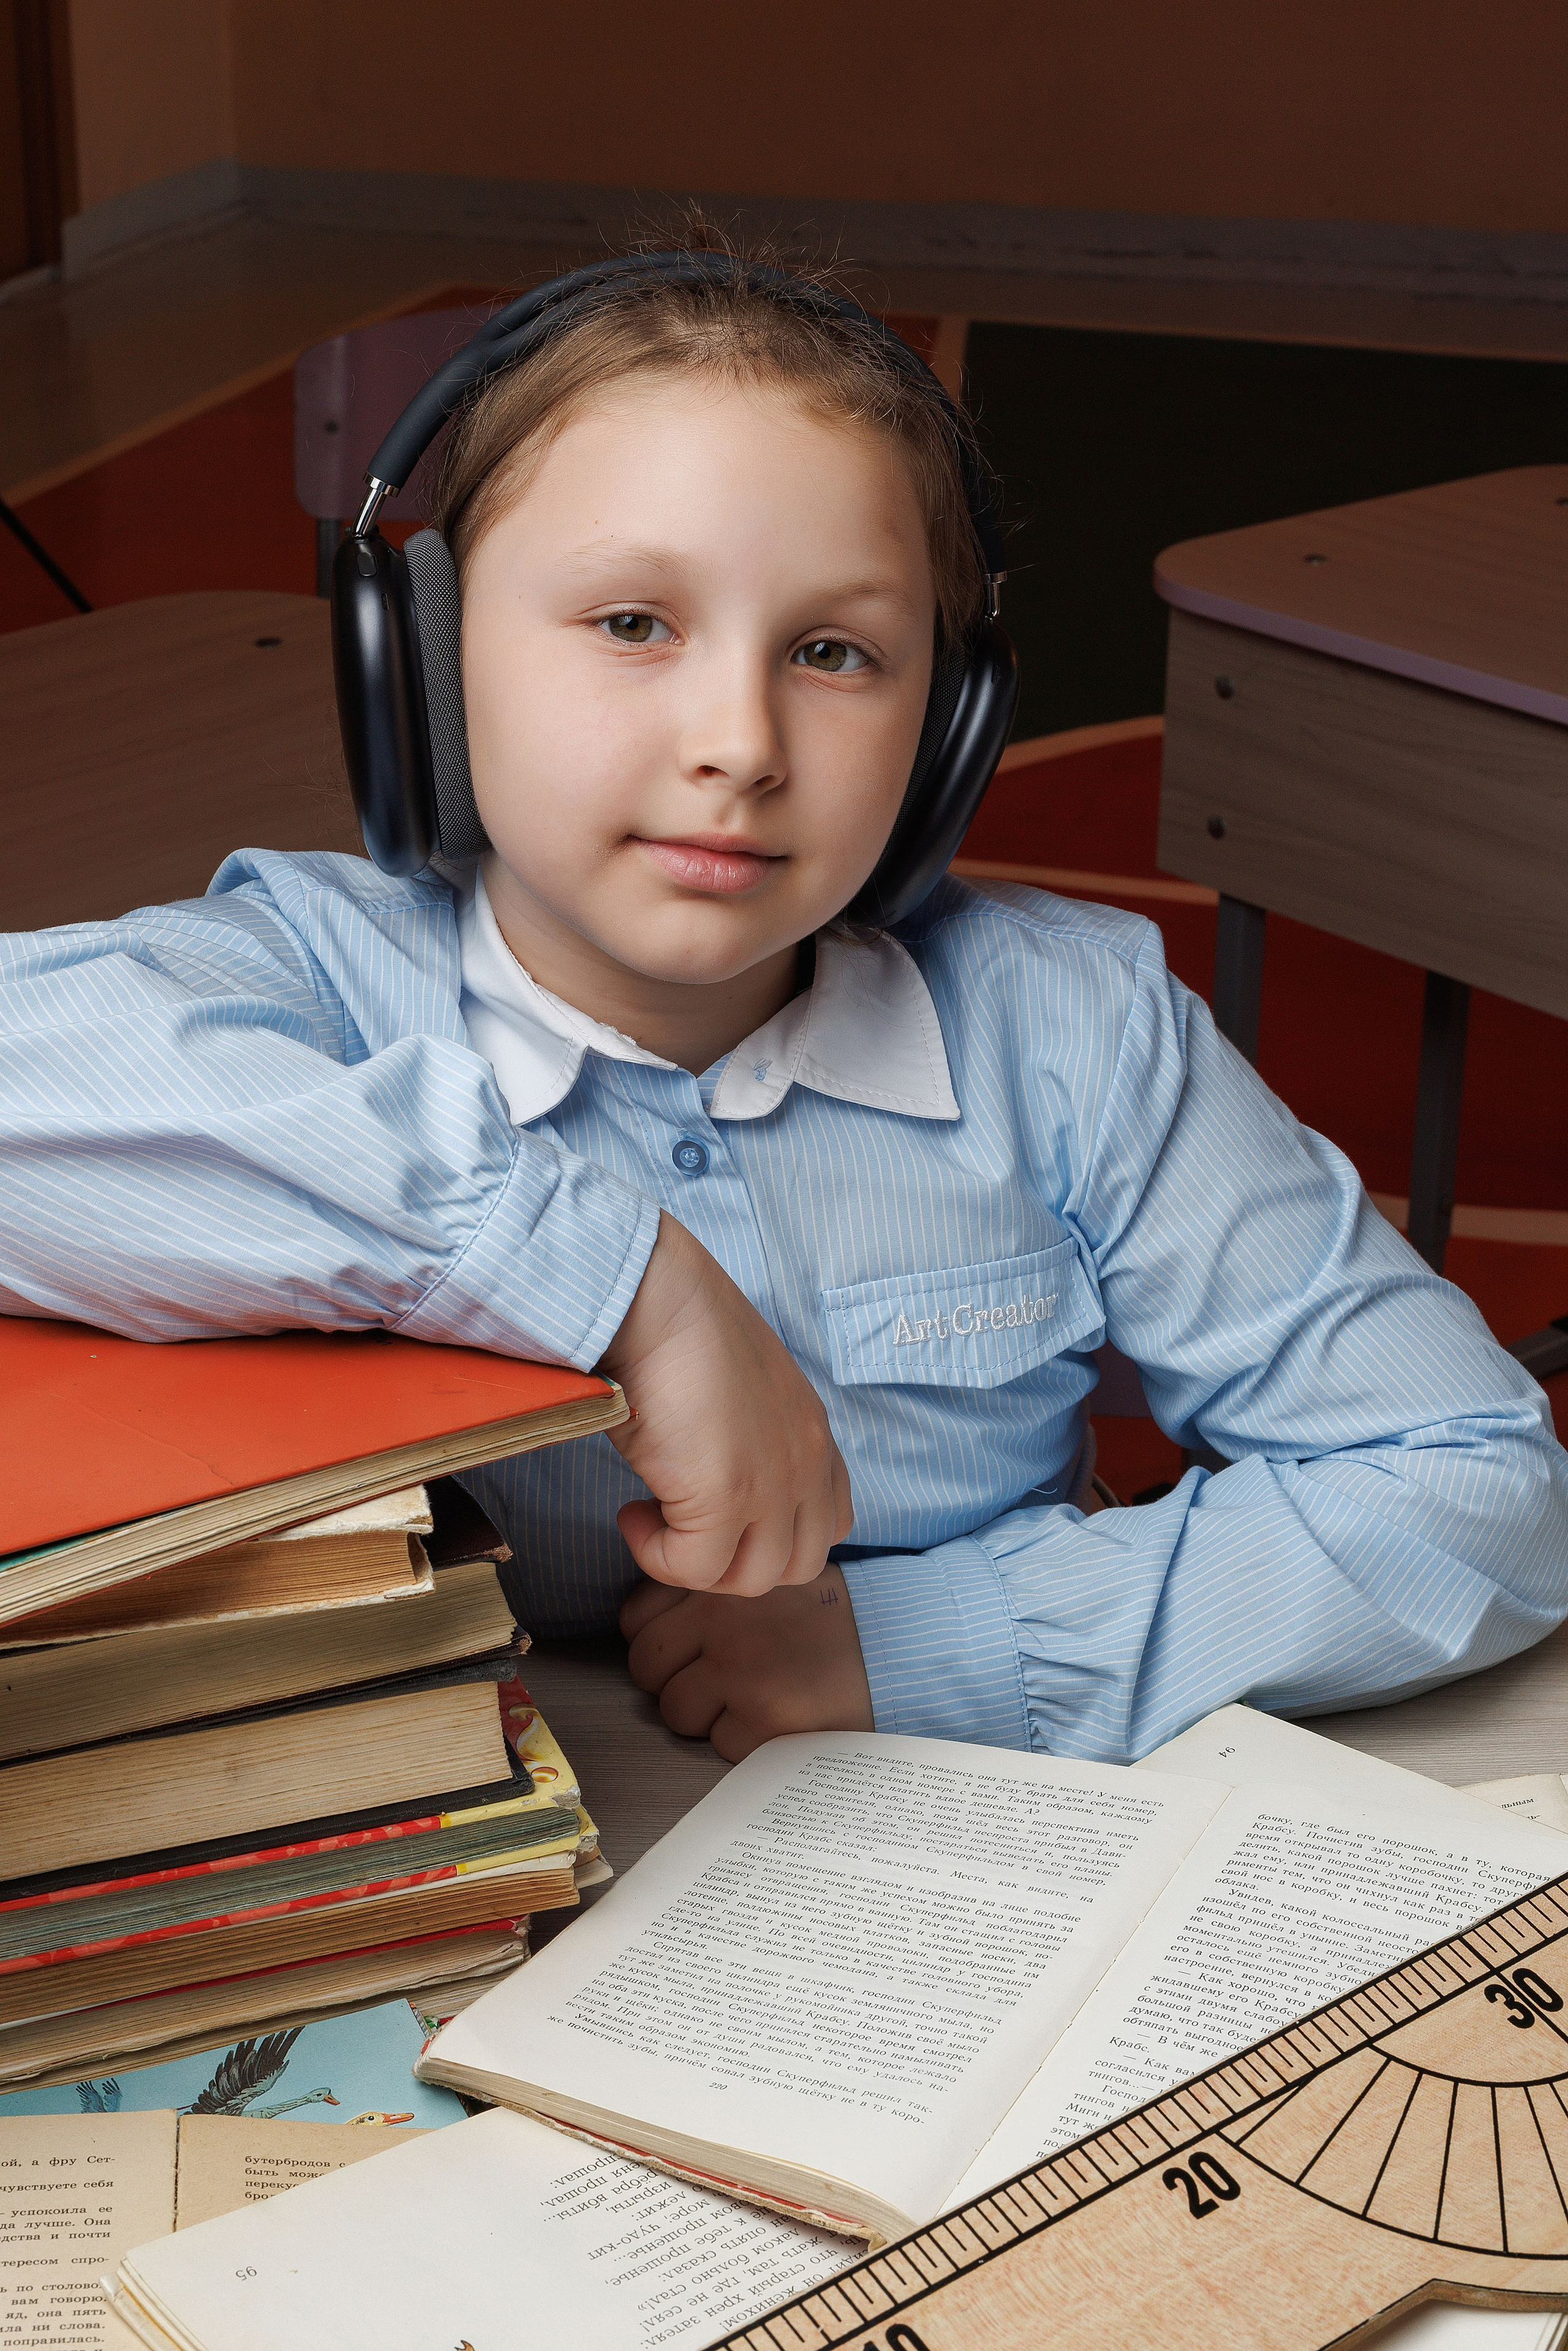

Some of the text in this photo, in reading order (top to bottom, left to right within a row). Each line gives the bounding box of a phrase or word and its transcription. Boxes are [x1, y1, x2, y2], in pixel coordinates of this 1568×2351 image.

[1218, 1746, 1236, 1758] 94
[807, 1779, 865, 1797] Господину
[867, 1791, 909, 1805] Крабсу
[930, 1803, 962, 1814] очень
[965, 1809, 1025, 1824] улыбалась
[1031, 1820, 1100, 1835] перспектива
[1106, 1831, 1139, 1841] иметь
[745, 1823, 878, 1852] господин Крабс сказал:
[1257, 1814, 1293, 1825] бочку,
[1300, 1821, 1321, 1830] где
[1326, 1825, 1351, 1836] был
[1356, 1833, 1376, 1841] его
[1382, 1838, 1438, 1857] порошок,
[1476, 1859, 1492, 1869] ту,
[1501, 1865, 1552, 1882] которая
[770, 1817, 836, 1835] Вернувшись
[854, 1834, 919, 1850] господином
[925, 1846, 1016, 1868] Скуперфильдом
[1036, 1868, 1063, 1877] свой
[1068, 1874, 1106, 1886] номер,
[742, 1851, 782, 1865] Окинув
[785, 1862, 846, 1878] помещение
[850, 1874, 903, 1890] взглядом
[918, 1888, 978, 1904] изобразив
[1000, 1903, 1029, 1913] лице
[1033, 1909, 1081, 1923] подобие
[1214, 1877, 1260, 1891] облака.
[1237, 1841, 1504, 1906] делить, какой порошок лучше пахнет: тот
[707, 1865, 1068, 1943] гримасу отвращения, господин Скуперфильд поблагодарил
[1228, 1888, 1410, 1942] Увидев, какой колоссальный
[1196, 1904, 1234, 1920] фильд
[1237, 1915, 1285, 1933] пришёл
[1299, 1932, 1349, 1949] уныние.
[1170, 1945, 1190, 1953] его
[1208, 1953, 1287, 1977] собственную
[1150, 1975, 1225, 1998] жидавшему
[1228, 1993, 1249, 2004] его
[1483, 1968, 1564, 2029] 30
[565, 2001, 750, 2058] вести таким образом экономию.
[598, 1970, 973, 2063] рядышком, господин Скуперфильд некоторое время смотрел
[1122, 2017, 1179, 2035] обтяпать
[1109, 2036, 1150, 2053] Крабс.
[709, 2082, 728, 2091] 220
[1065, 2102, 1101, 2118] Миги
[0, 2158, 22, 2168] ой,
[48, 2157, 77, 2167] фру
[86, 2155, 115, 2164] Сет-
[244, 2155, 331, 2168] бутербродов
[244, 2167, 279, 2177] быть
[83, 2179, 114, 2189] себя
[540, 2158, 641, 2207] еня прошал,
[605, 2172, 673, 2214] изрыты,
[1162, 2151, 1242, 2220] 20
[244, 2191, 276, 2202] бро
[543, 2193, 609, 2222] вбиты...
[631, 2191, 687, 2222] лежит:
[10, 2207, 87, 2218] успокоила
[24, 2221, 75, 2230] лучше.
[83, 2217, 111, 2226] Она
[733, 2217, 748, 2227] к
[0, 2234, 41, 2243] дства
[587, 2198, 711, 2261] море; чудо-кит
[613, 2217, 708, 2262] прощенье...
[693, 2225, 733, 2245] тебе
[720, 2227, 767, 2251] опять
[750, 2227, 801, 2255] лаком
[781, 2235, 824, 2259] жать
[0, 2257, 110, 2268] тересом спро-
[235, 2266, 258, 2282] 95
[605, 2243, 693, 2286] прошенье,
[658, 2250, 717, 2282] сказал:
[691, 2254, 750, 2285] больно
[742, 2258, 780, 2277] там,
[42, 2282, 103, 2292] столово
[637, 2284, 687, 2311] стал!»
[711, 2276, 741, 2293] где
[50, 2296, 107, 2304] говорю.
[640, 2249, 839, 2350] что старый хрен затеял:
[686, 2292, 710, 2306] не
[639, 2305, 683, 2333] сеял!
[3, 2336, 105, 2347] поправилась.
